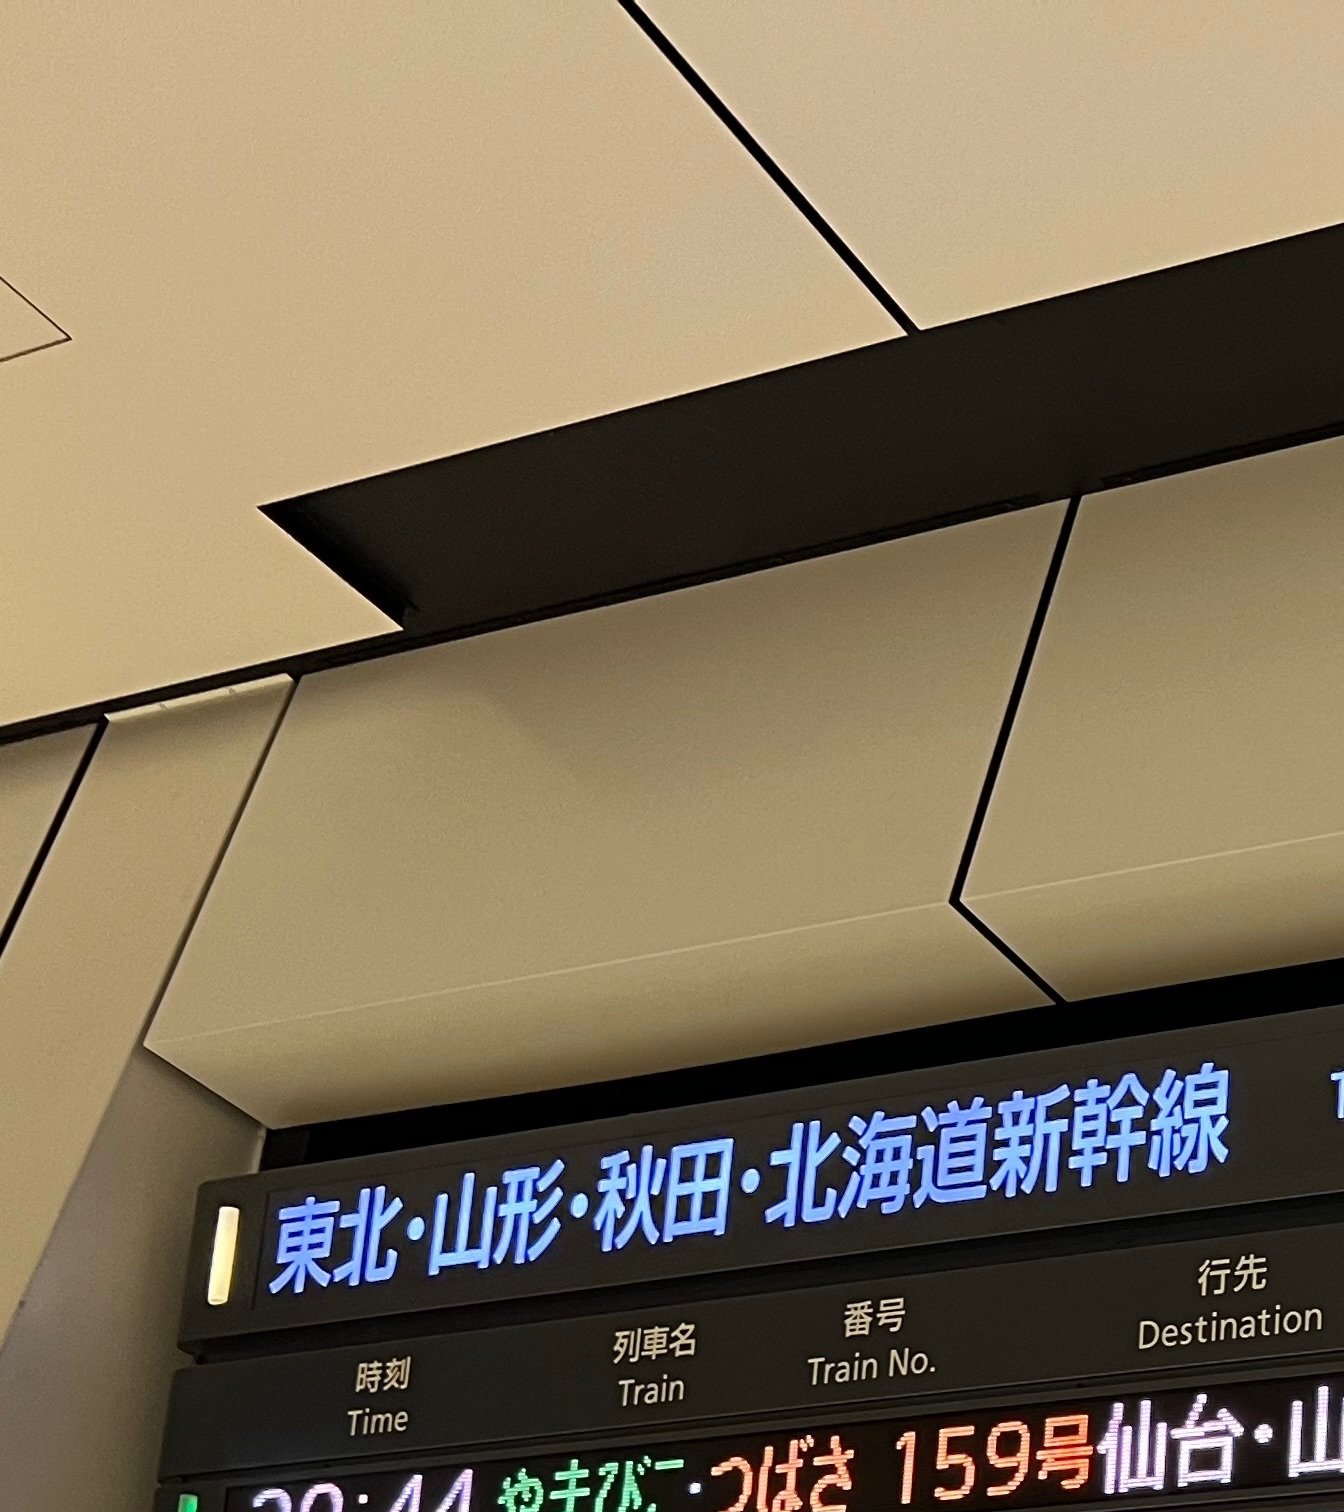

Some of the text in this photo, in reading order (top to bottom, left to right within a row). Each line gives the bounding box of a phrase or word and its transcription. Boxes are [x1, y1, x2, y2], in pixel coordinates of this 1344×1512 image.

[267, 1061, 1231, 1295] 東北・山形・秋田・北海道新幹線
[1197, 1253, 1268, 1296] 行先
[843, 1297, 906, 1339] 番号
[1138, 1303, 1324, 1350] Destination
[612, 1321, 697, 1365] 列車名
[354, 1355, 412, 1394] 時刻
[807, 1347, 936, 1386] Train No.
[618, 1374, 685, 1407] Train
[347, 1405, 410, 1437] Time
[895, 1413, 1093, 1505] 159号
